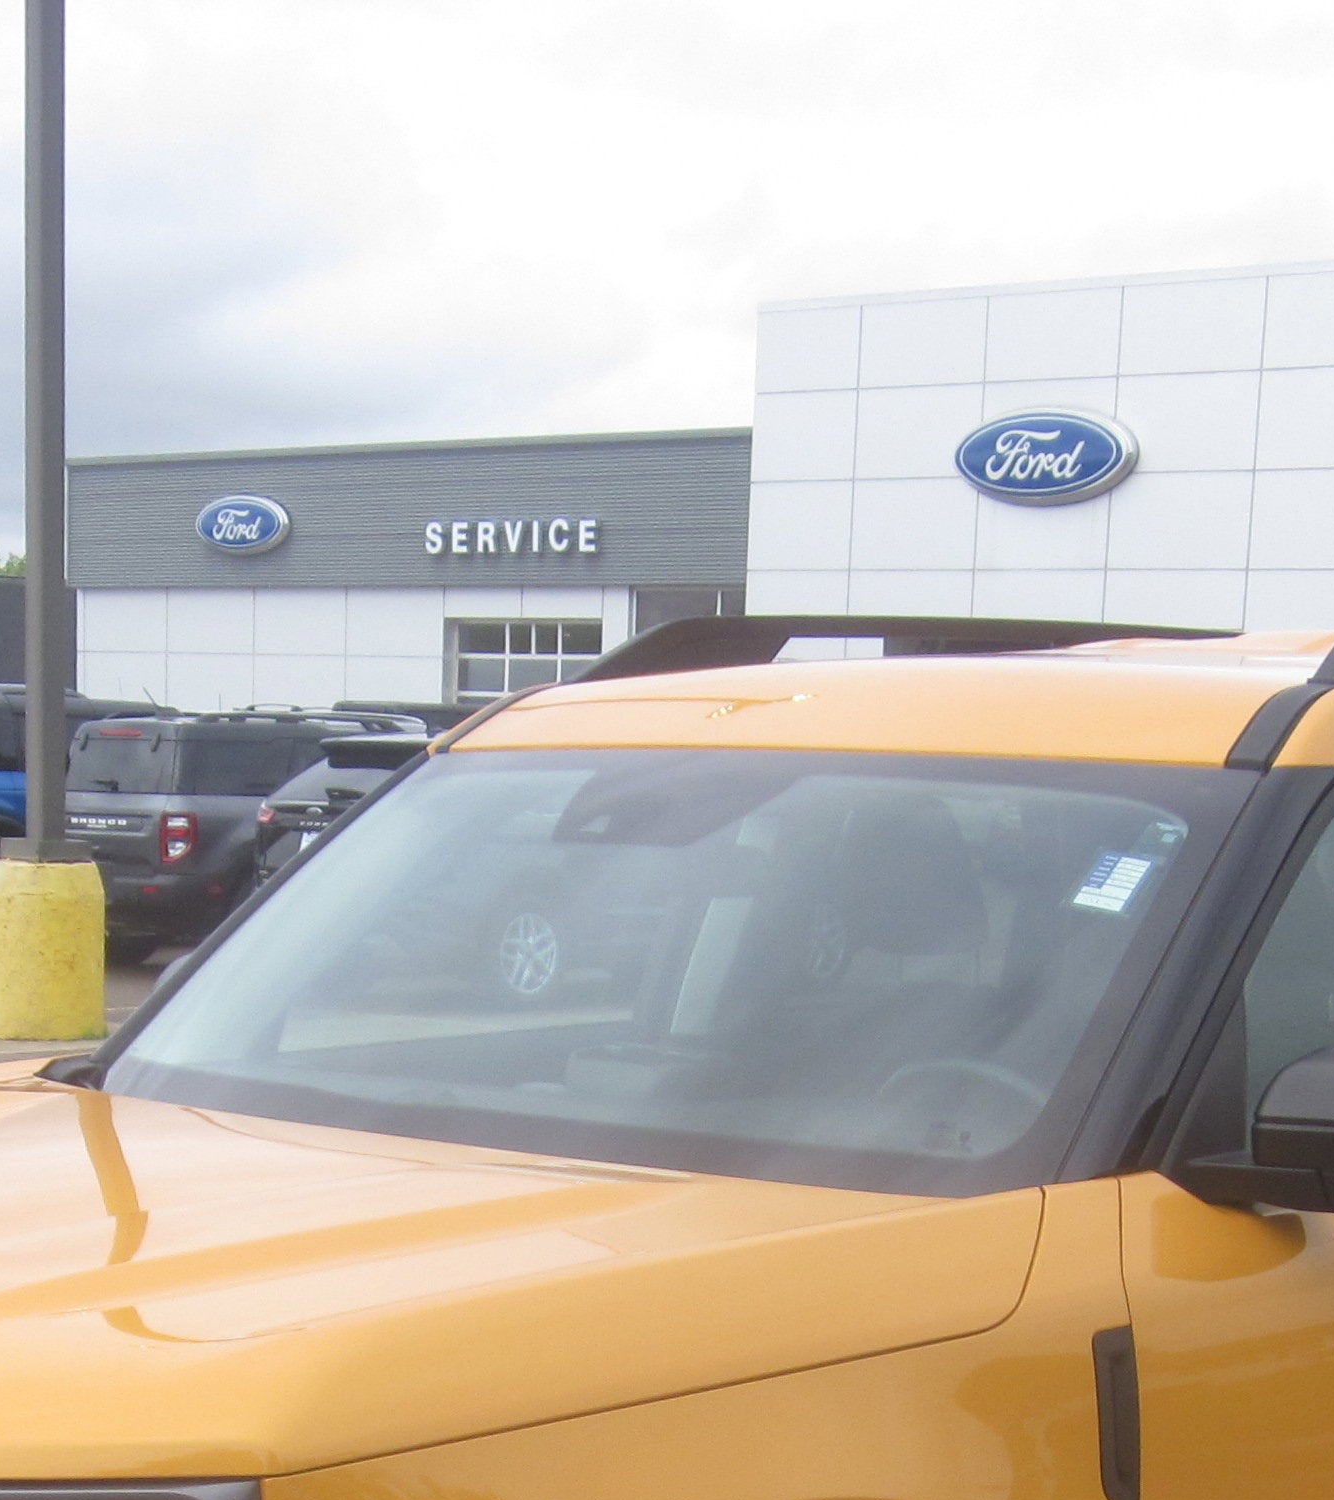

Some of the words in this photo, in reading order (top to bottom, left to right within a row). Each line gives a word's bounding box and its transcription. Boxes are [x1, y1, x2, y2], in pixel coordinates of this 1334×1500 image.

[985, 429, 1086, 481] Ford
[211, 508, 262, 541] Ford
[425, 518, 598, 554] SERVICE
